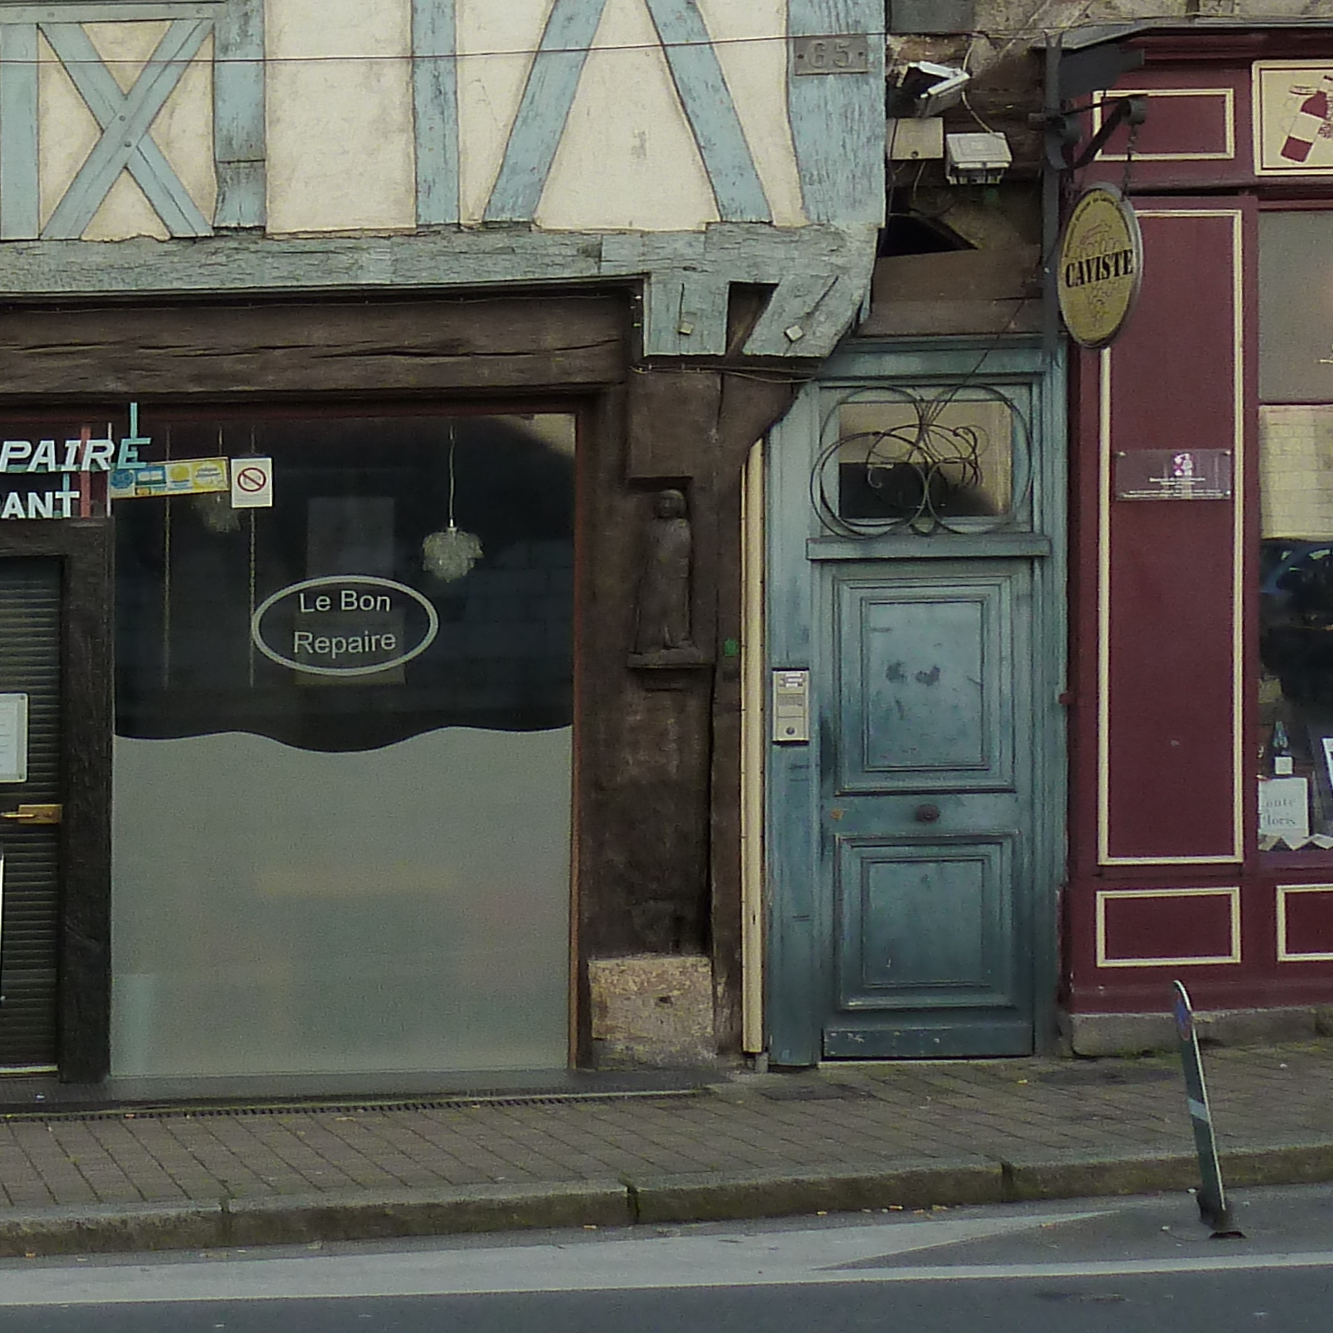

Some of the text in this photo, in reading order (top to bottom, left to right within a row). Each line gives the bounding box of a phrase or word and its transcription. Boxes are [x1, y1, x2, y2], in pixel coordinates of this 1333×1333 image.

[809, 39, 853, 69] 65
[1066, 249, 1133, 288] CAVISTE
[299, 590, 391, 613] Le Bon
[293, 630, 397, 659] Repaire
